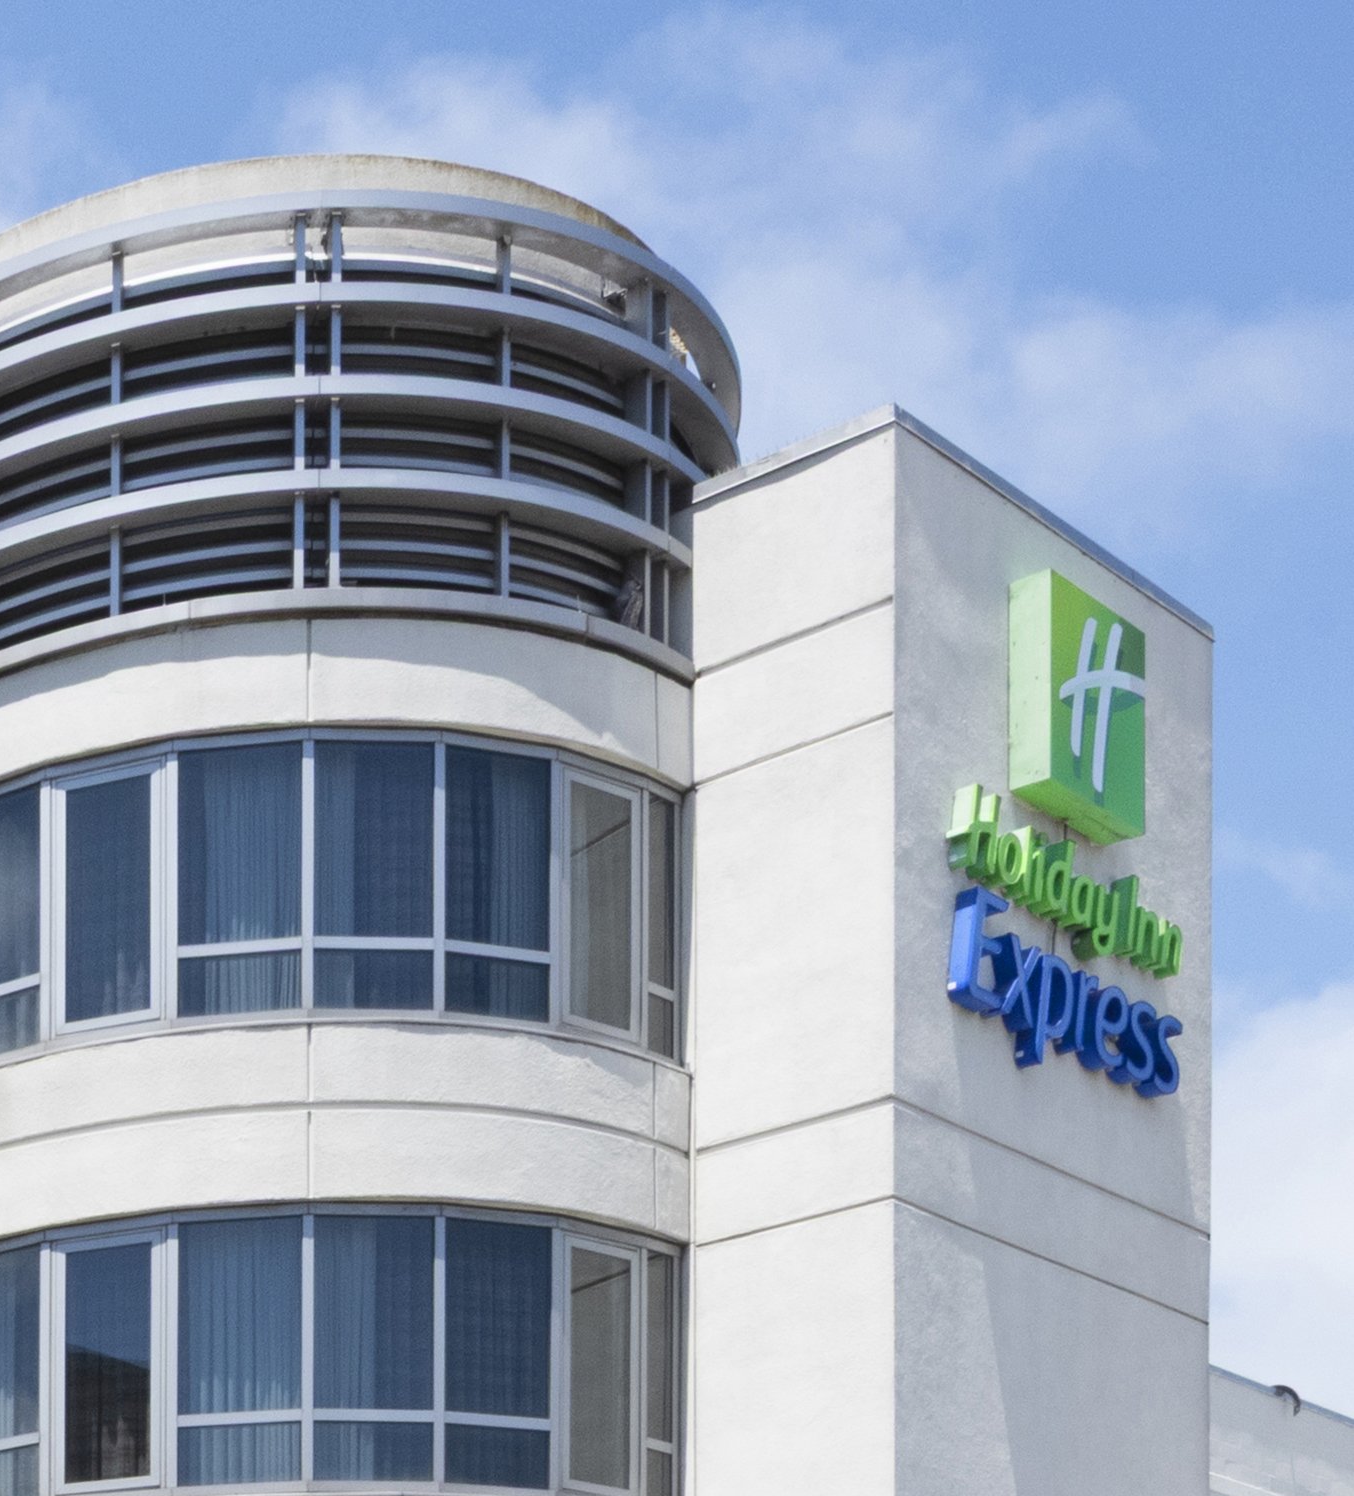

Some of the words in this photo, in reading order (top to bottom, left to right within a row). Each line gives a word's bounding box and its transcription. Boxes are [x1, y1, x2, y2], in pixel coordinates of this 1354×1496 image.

[945, 783, 1120, 961] Holiday
[1112, 874, 1183, 979] Inn
[947, 886, 1184, 1099] Express
